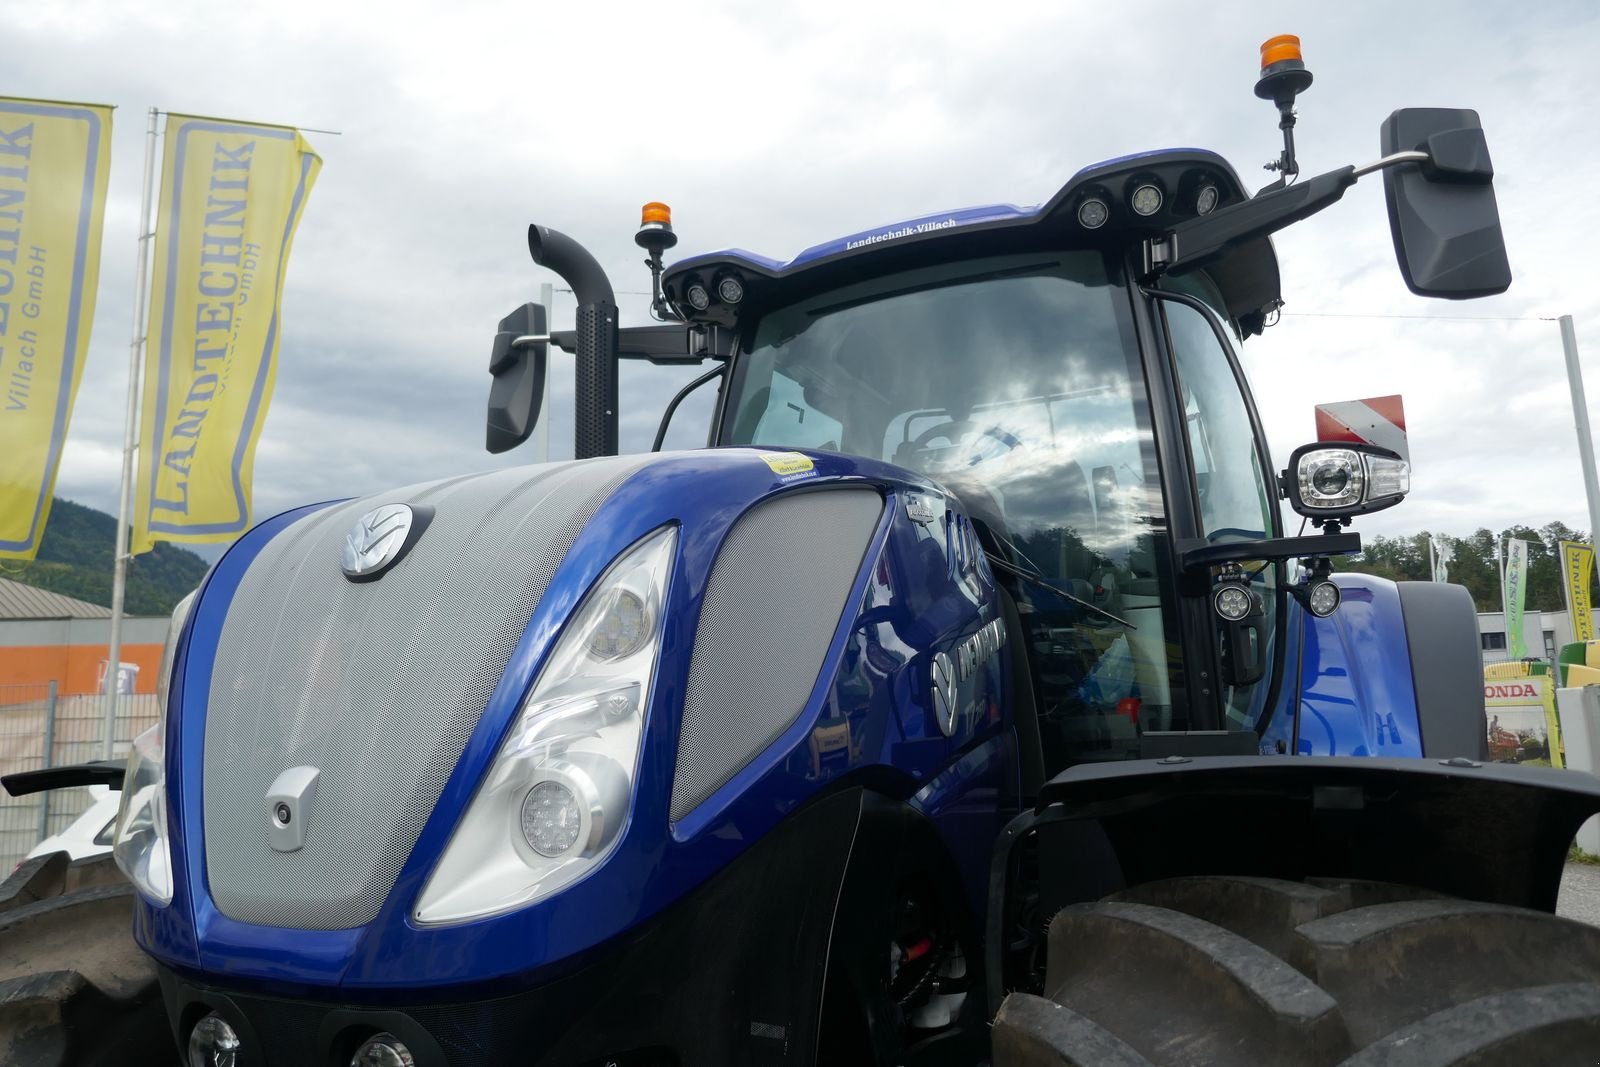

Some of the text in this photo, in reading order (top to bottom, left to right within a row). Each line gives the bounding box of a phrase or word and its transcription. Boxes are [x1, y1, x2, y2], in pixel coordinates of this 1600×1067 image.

[846, 219, 956, 250] Landtechnik-Villach
[5, 330, 38, 412] Villach
[22, 245, 47, 319] GmbH
[1484, 684, 1538, 698] ONDA
